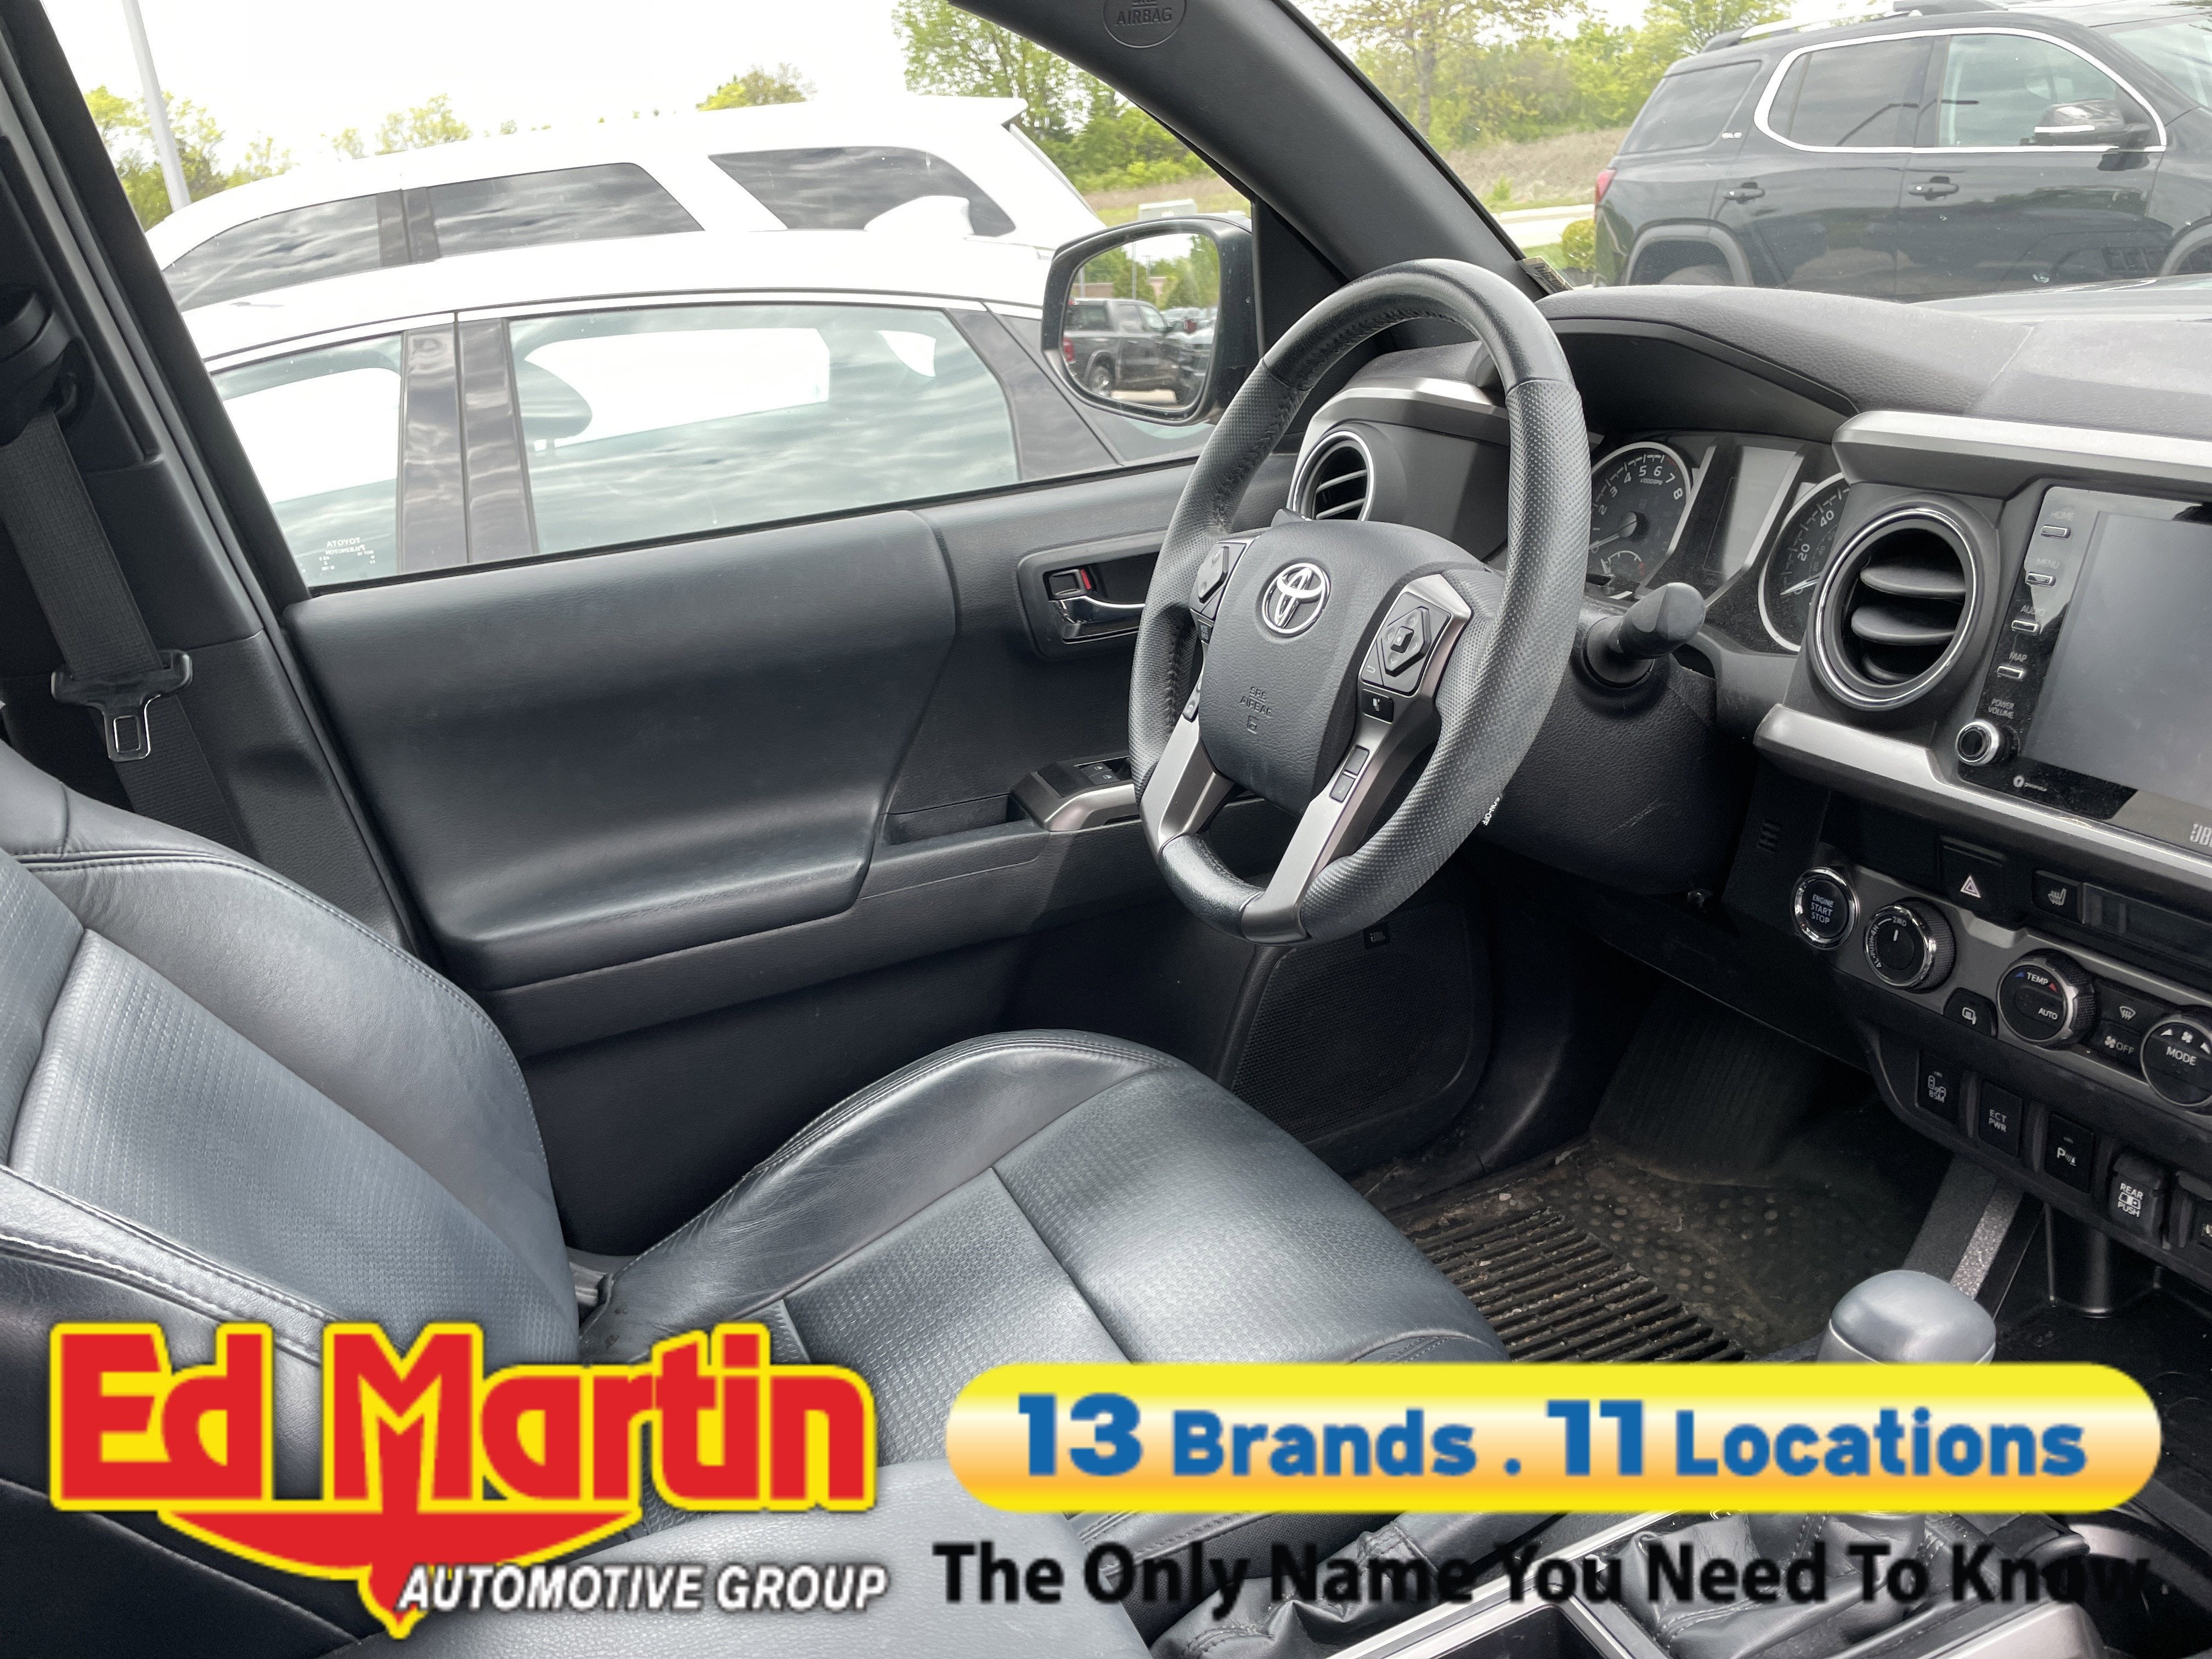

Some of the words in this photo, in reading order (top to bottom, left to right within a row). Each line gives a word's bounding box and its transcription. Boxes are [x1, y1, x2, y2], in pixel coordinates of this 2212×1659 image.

[1115, 7, 1172, 26] AIRBAG
[1638, 465, 1647, 477] 5
[1654, 465, 1663, 477] 6
[1666, 472, 1676, 483] 7
[1623, 472, 1632, 484] 4
[1609, 486, 1618, 498] 3
[1673, 487, 1683, 500] 8
[1598, 504, 1607, 515] 2
[1820, 510, 1834, 527] 40
[1797, 543, 1810, 561] 20
[2035, 557, 2060, 569] MENU
[2019, 605, 2046, 617] AUDIO
[2008, 651, 2027, 662] MAP
[1240, 695, 1273, 719] AIRBAG
[1991, 698, 2015, 710] POWER
[1988, 706, 2014, 719] VOLUME
[1812, 894, 1835, 908] ENGINE
[1811, 902, 1833, 917] START
[1811, 911, 1830, 924] STOP
[1892, 916, 1907, 927] 2WD
[2027, 971, 2049, 985] TEMP
[2038, 1008, 2058, 1020] AUTO
[2116, 1042, 2134, 1054] OFF
[2166, 1046, 2197, 1066] MODE
[1990, 1108, 2007, 1122] ECT
[1989, 1117, 2006, 1132] PWR
[2120, 1182, 2143, 1200] REAR
[2118, 1201, 2140, 1217] PUSH
